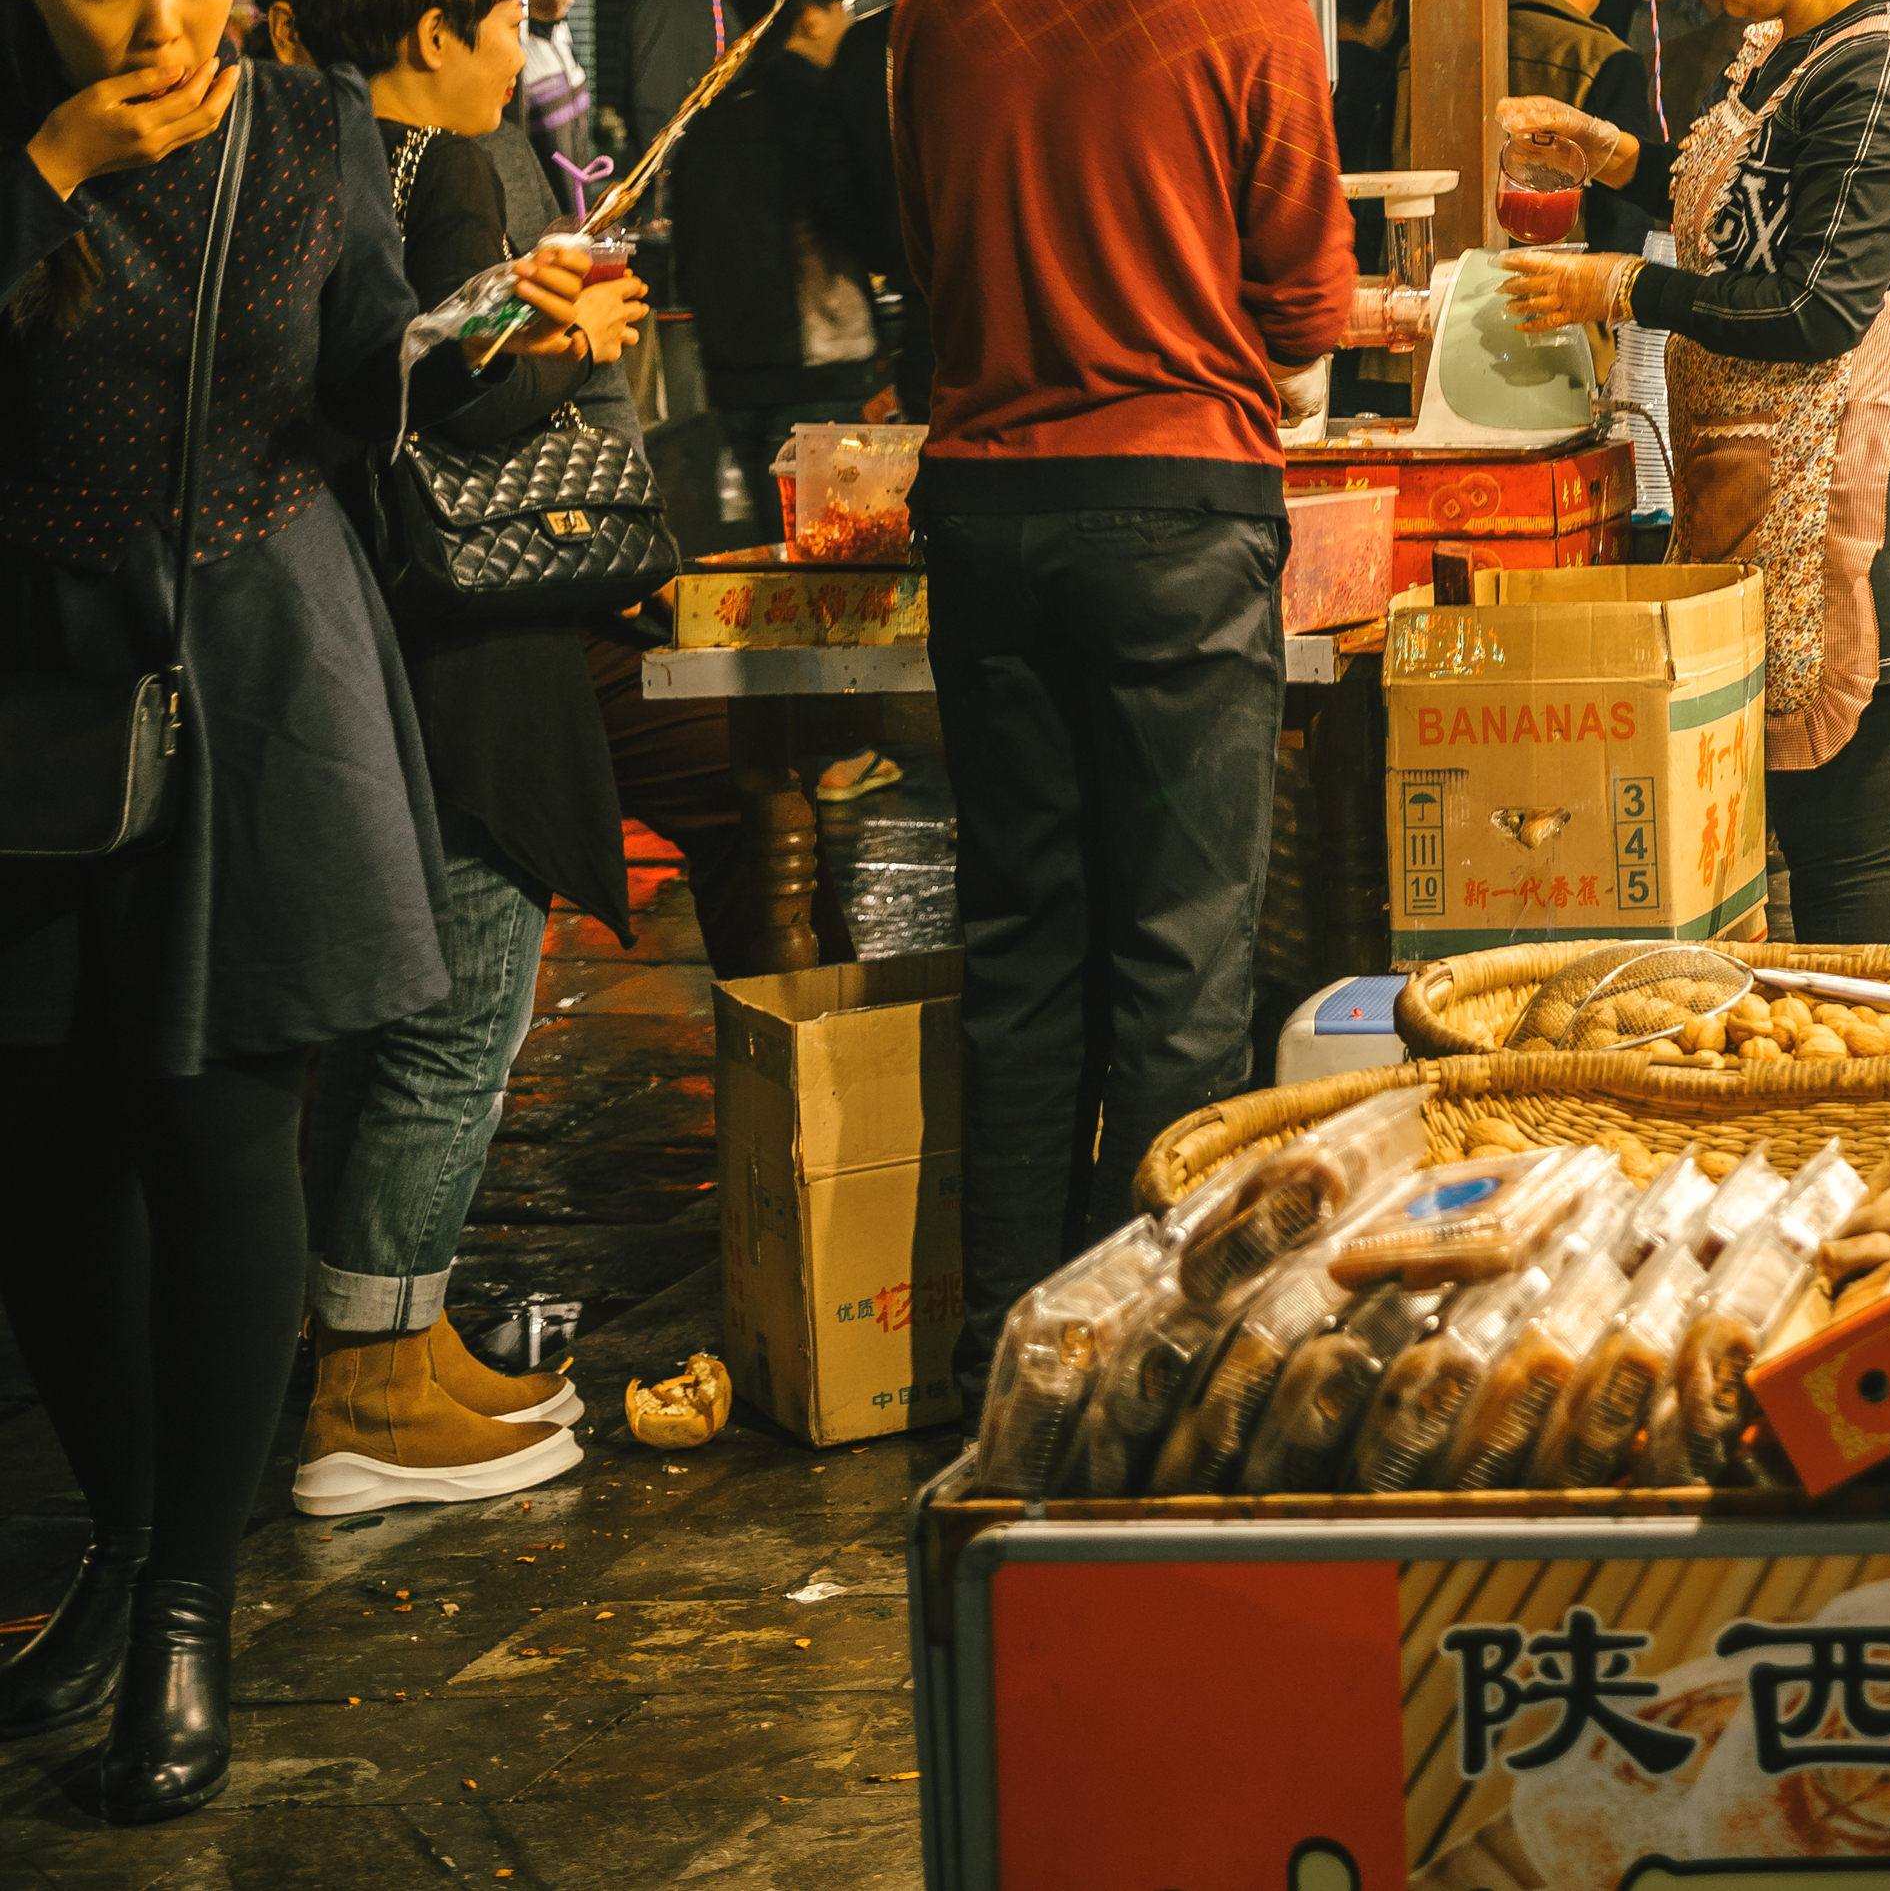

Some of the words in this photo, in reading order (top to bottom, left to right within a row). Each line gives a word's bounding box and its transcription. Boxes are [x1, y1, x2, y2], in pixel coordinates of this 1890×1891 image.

[1418, 700, 1638, 746] BANANAS
[1622, 783, 1646, 818] 3
[1624, 826, 1648, 861] 4
[1410, 876, 1438, 898] 10
[1463, 874, 1601, 910] 新一代香蕉
[1627, 870, 1650, 904] 5
[836, 1297, 876, 1324] 优质
[871, 1380, 962, 1410] 中国核
